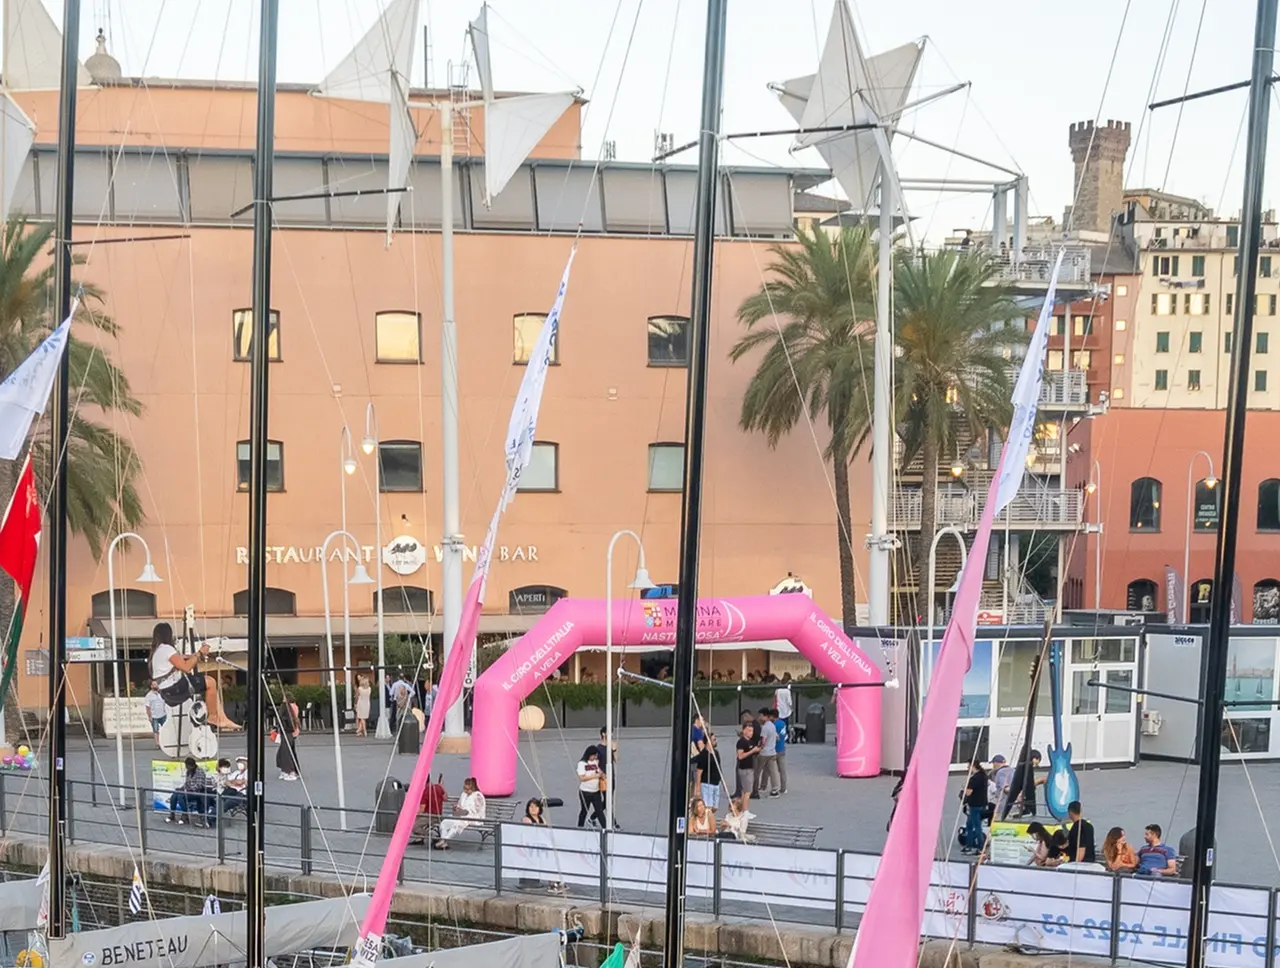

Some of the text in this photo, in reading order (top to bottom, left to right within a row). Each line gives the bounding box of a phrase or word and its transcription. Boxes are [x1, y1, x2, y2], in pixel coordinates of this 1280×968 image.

[236, 545, 373, 564] RSTAURANT
[501, 548, 538, 562] BAR
[539, 650, 562, 673] VELA
[827, 646, 847, 669] VELA
[101, 935, 188, 966] BENETEAU
